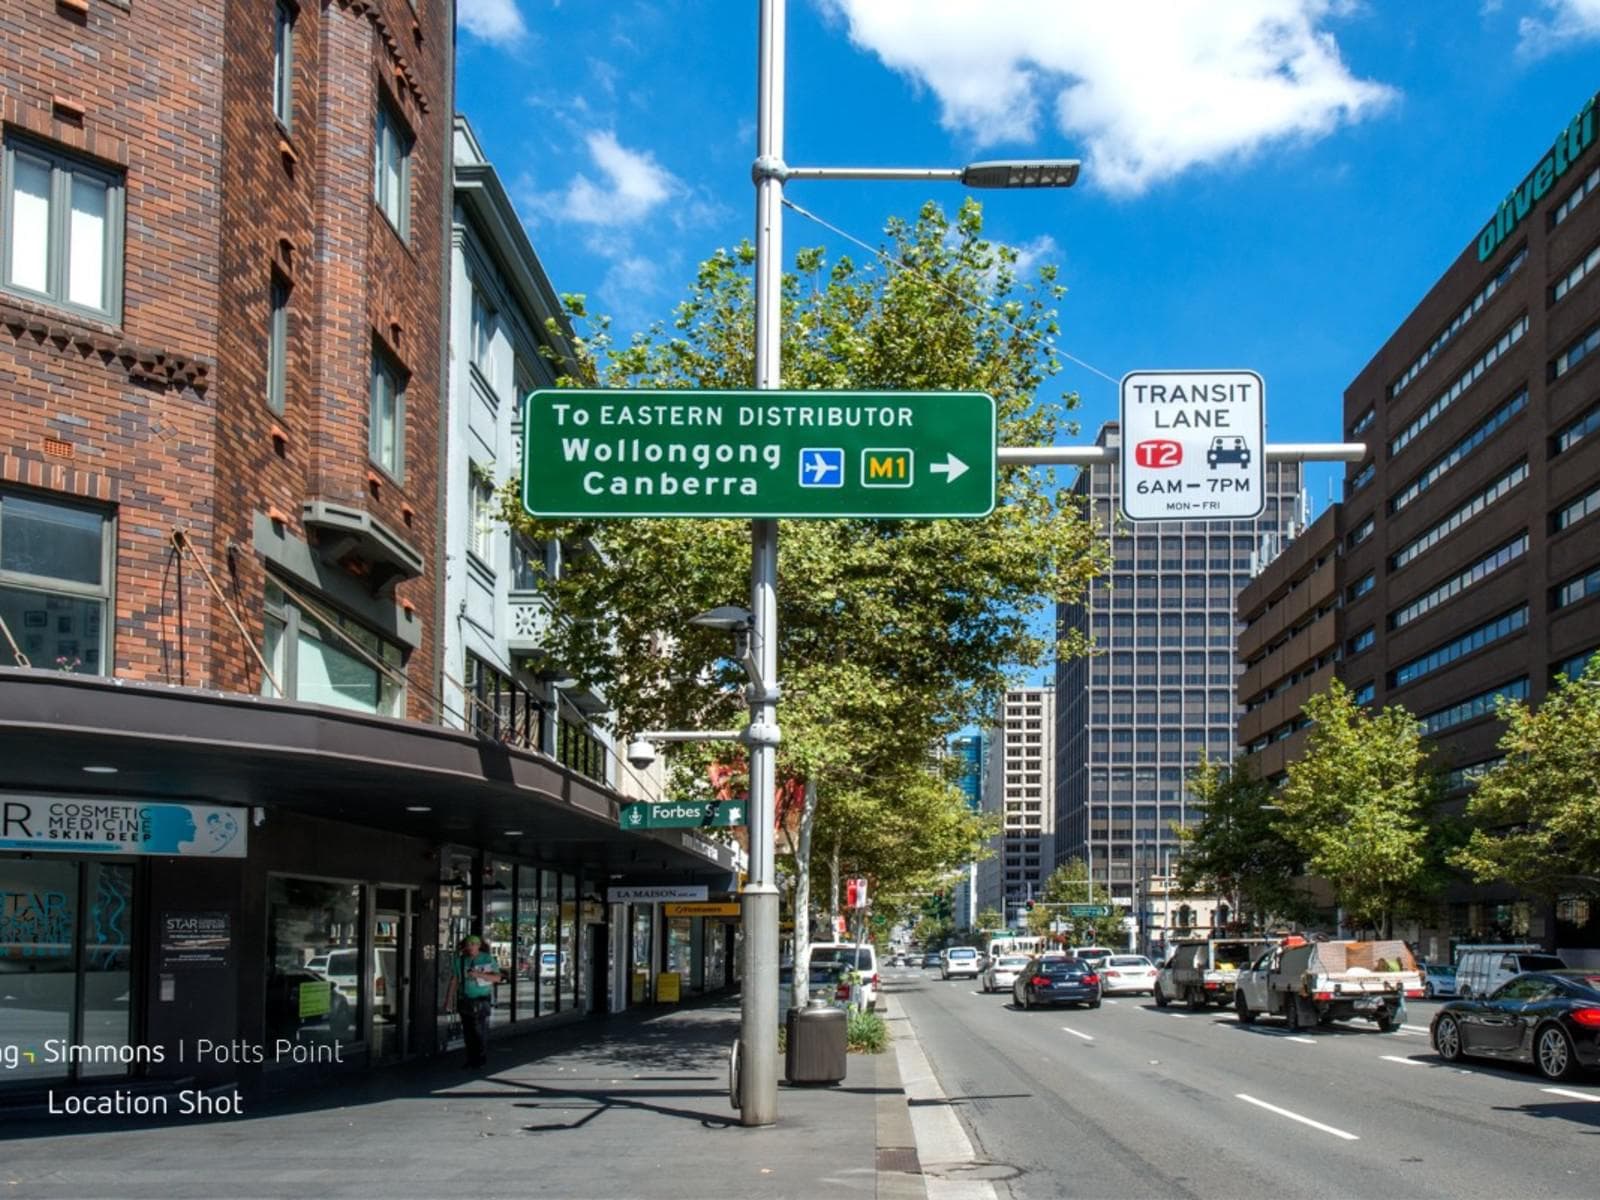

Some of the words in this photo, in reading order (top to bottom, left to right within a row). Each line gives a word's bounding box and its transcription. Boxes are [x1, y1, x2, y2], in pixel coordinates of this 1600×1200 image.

[1478, 97, 1597, 262] olivetti
[1133, 384, 1252, 403] TRANSIT
[552, 404, 589, 426] To
[600, 406, 723, 426] EASTERN
[738, 407, 914, 427] DISTRIBUTOR
[1155, 409, 1231, 428] LANE
[561, 437, 782, 470] Wollongong
[1140, 443, 1178, 465] T2
[869, 458, 906, 479] M1
[583, 471, 758, 495] Canberra
[49, 803, 152, 819] COSMETIC
[652, 805, 701, 819] Forbes
[49, 816, 152, 832] MEDICINE
[49, 829, 94, 841] SKIN
[106, 831, 153, 842] DEEP
[617, 890, 630, 898] LA
[633, 889, 677, 898] MAISON
[166, 918, 198, 930] STAR
